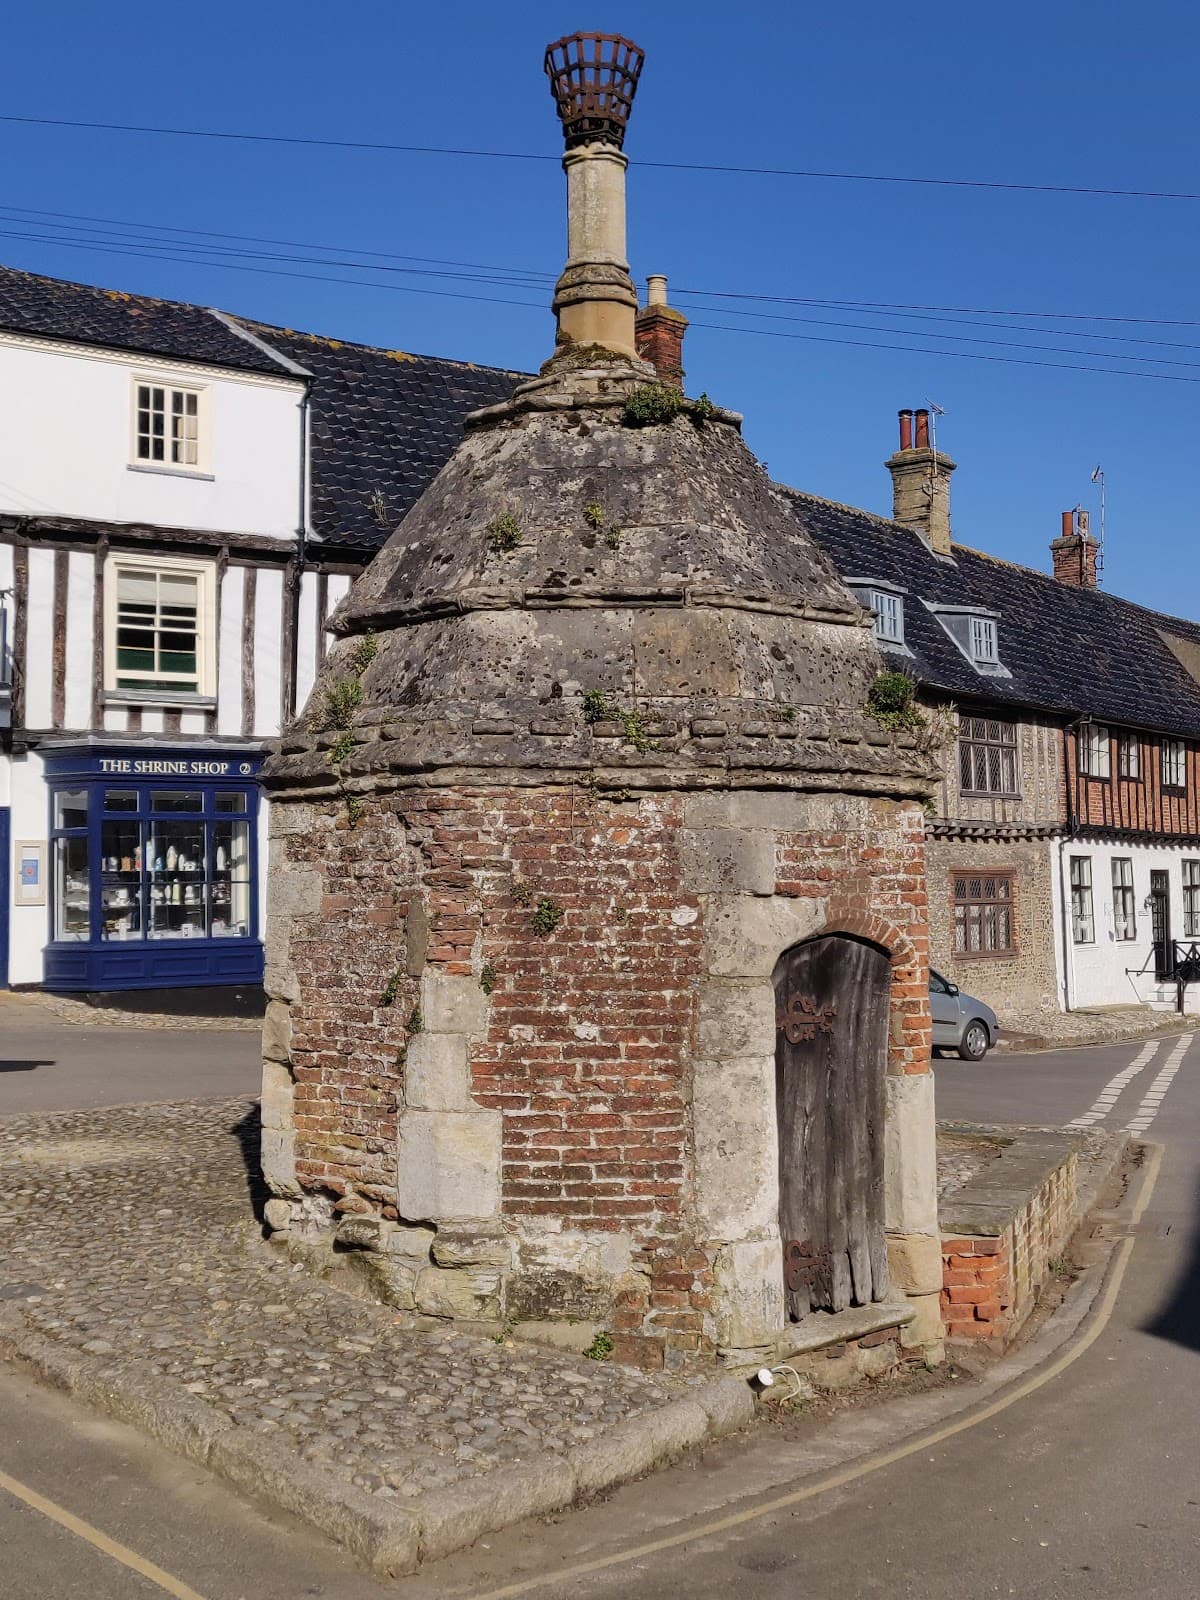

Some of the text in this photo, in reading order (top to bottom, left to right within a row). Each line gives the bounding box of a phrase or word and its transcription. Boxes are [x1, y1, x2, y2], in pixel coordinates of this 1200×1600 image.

[100, 760, 228, 774] THE SHRINE SHOP
